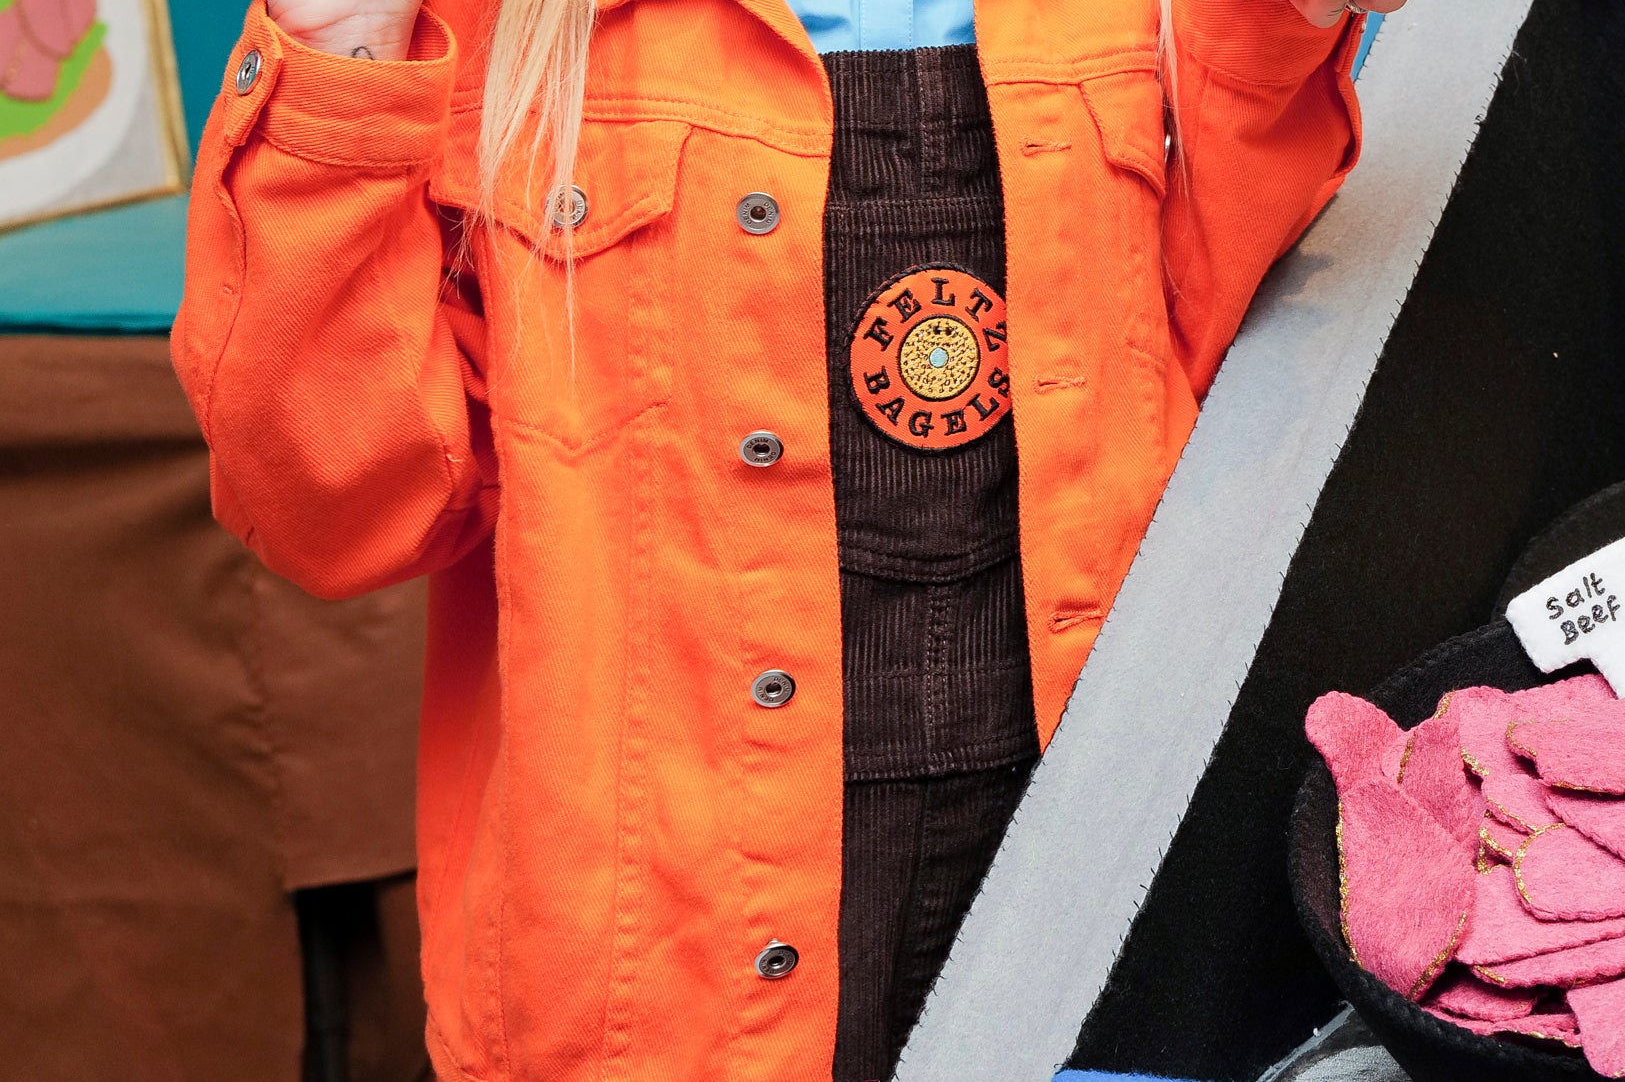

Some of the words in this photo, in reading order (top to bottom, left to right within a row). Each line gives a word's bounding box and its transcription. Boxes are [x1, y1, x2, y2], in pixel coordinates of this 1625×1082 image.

[863, 364, 1010, 438] BAGELS
[1545, 572, 1607, 621] Salt
[1560, 594, 1621, 646] Beef
